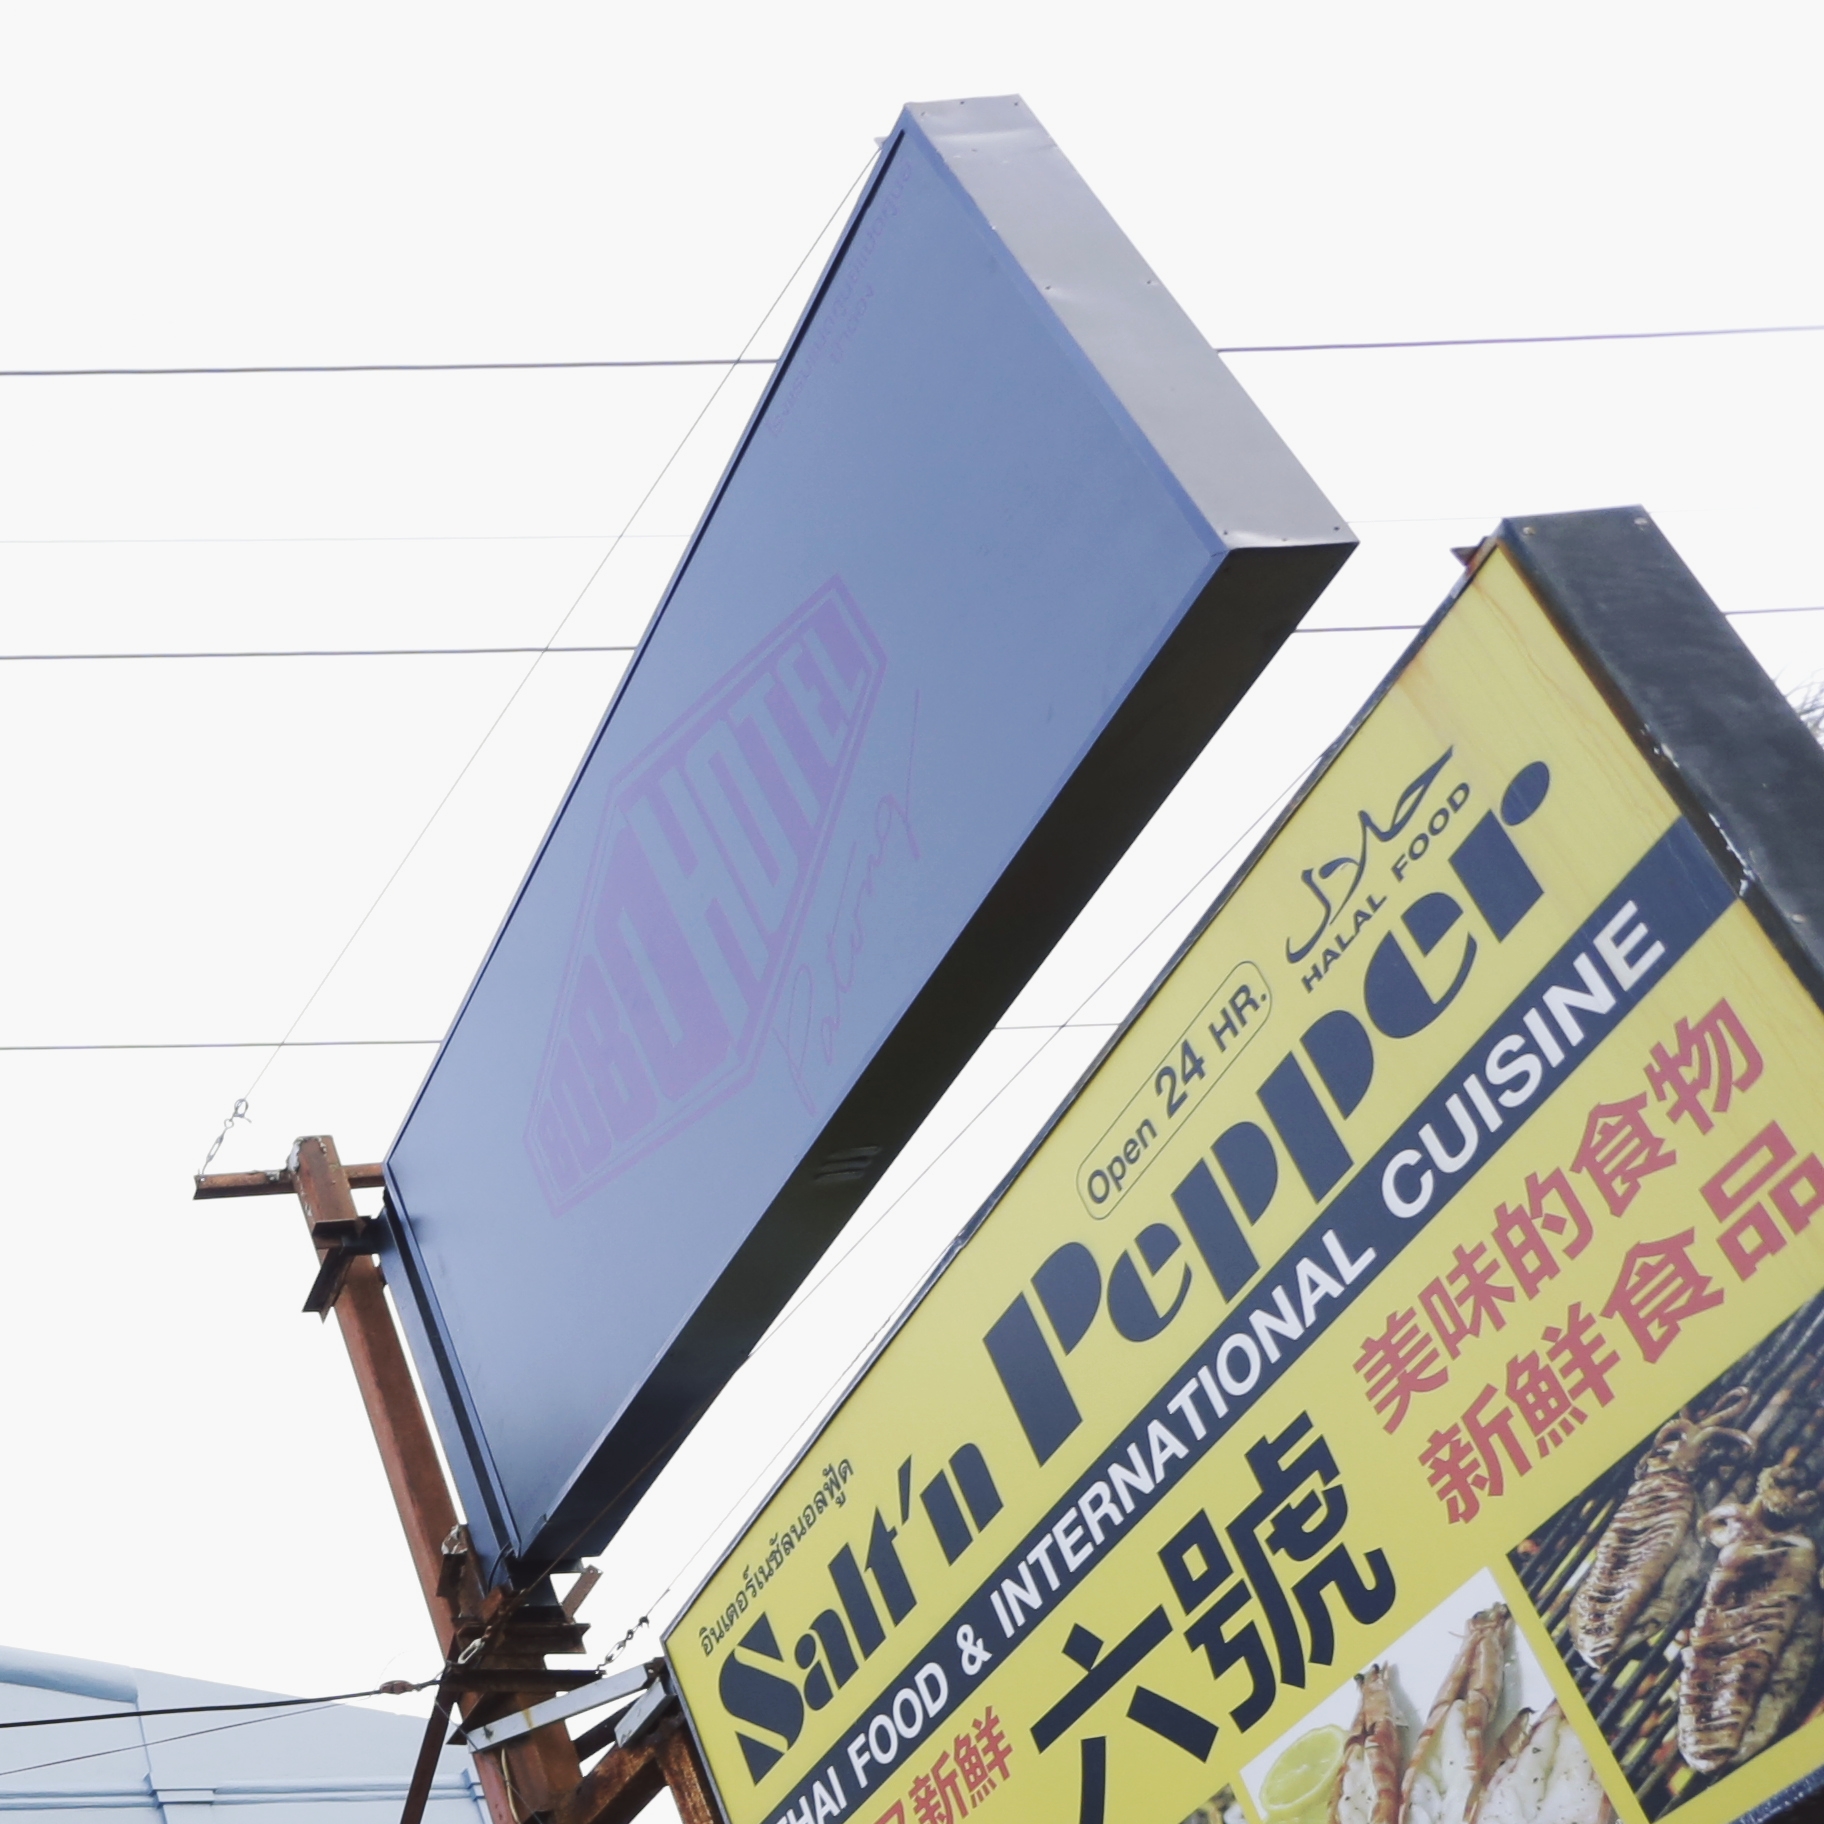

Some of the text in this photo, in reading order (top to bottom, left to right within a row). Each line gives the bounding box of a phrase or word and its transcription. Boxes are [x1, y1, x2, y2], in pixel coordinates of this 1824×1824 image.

[618, 612, 866, 1046] HOTEL
[776, 688, 921, 1117] Patong
[1300, 781, 1471, 995] HALAL FOOD
[716, 761, 1551, 1787] Salt'n Pepper
[1086, 983, 1268, 1206] Open 24 HR.
[1352, 997, 1765, 1436] 美味的食物
[847, 1662, 951, 1789] FOOD
[955, 1624, 994, 1677] &
[988, 1227, 1378, 1639] INTERNATIONAL
[1381, 899, 1668, 1220] CUISINE
[1418, 1119, 1824, 1525] 新鮮食品
